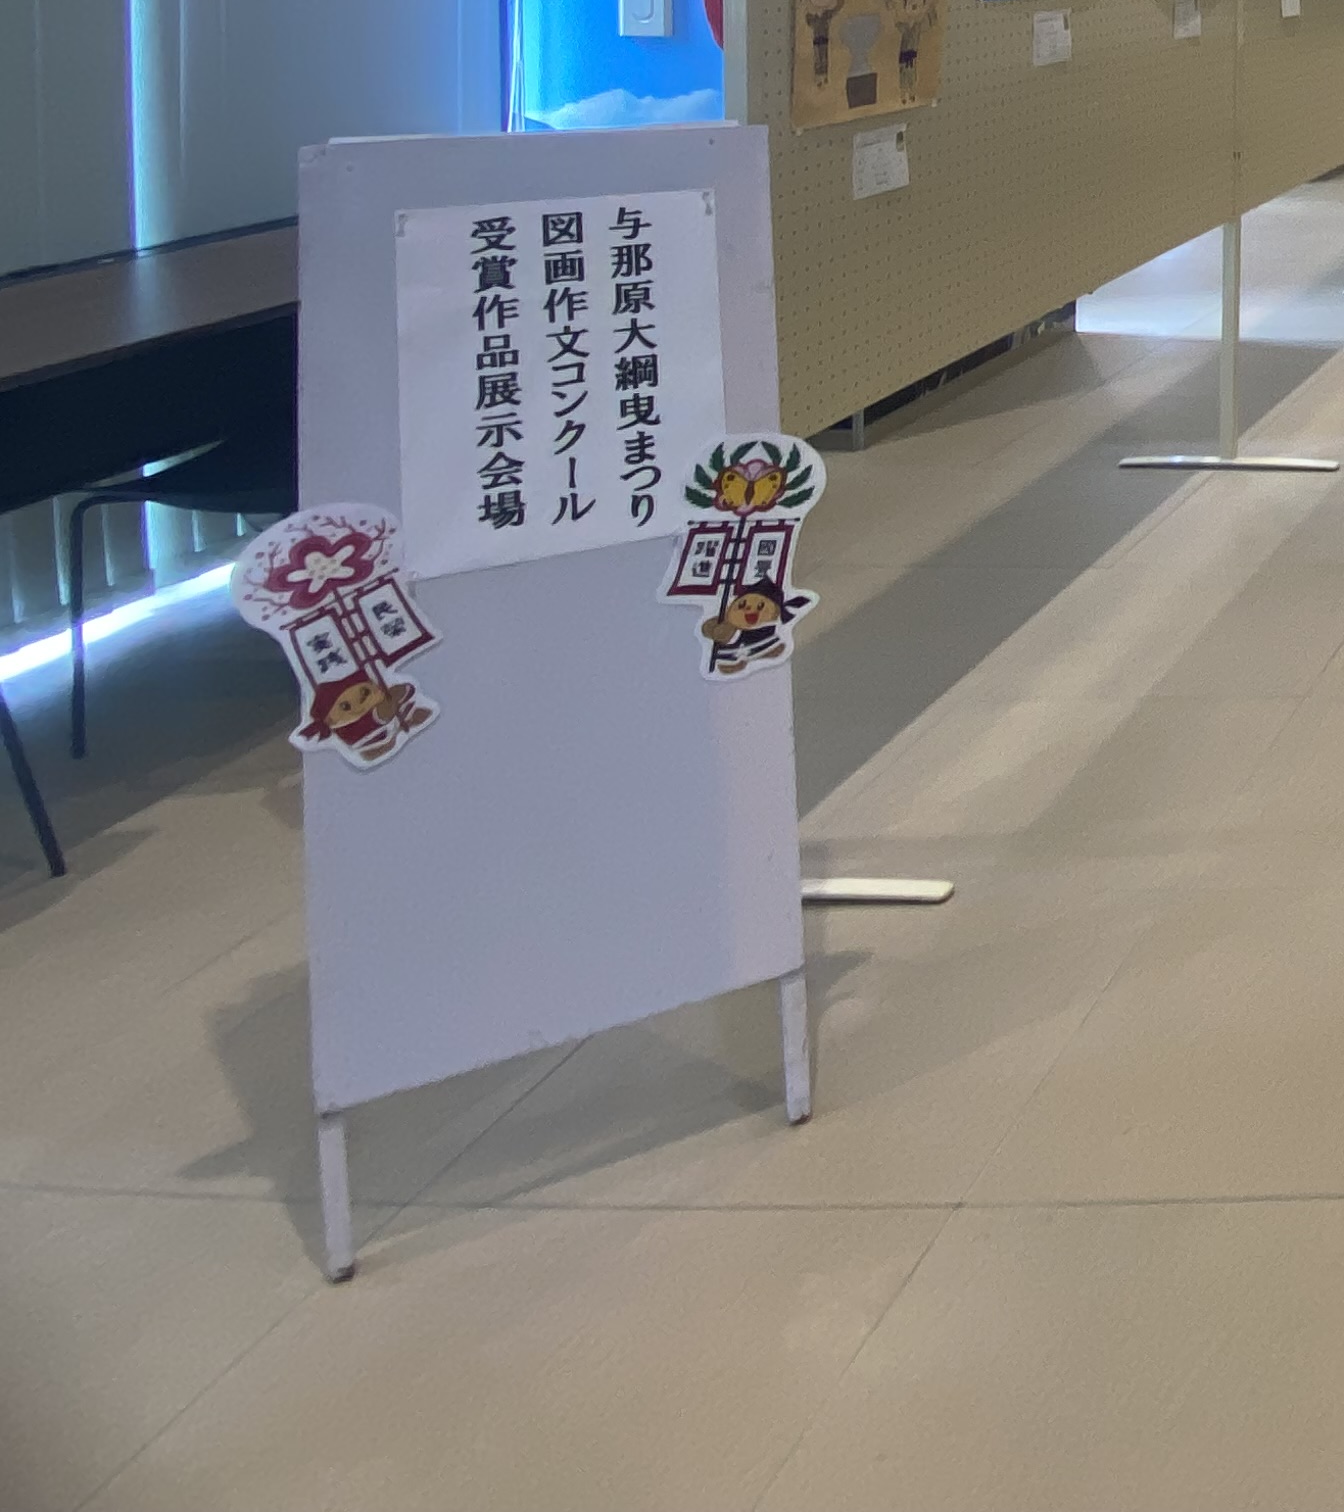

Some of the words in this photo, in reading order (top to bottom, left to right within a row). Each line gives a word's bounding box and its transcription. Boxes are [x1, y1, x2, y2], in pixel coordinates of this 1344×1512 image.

[470, 216, 526, 530] 受賞作品展示会場
[542, 211, 596, 526] 図画作文コンクール
[608, 207, 662, 528] 与那原大綱曳まつり
